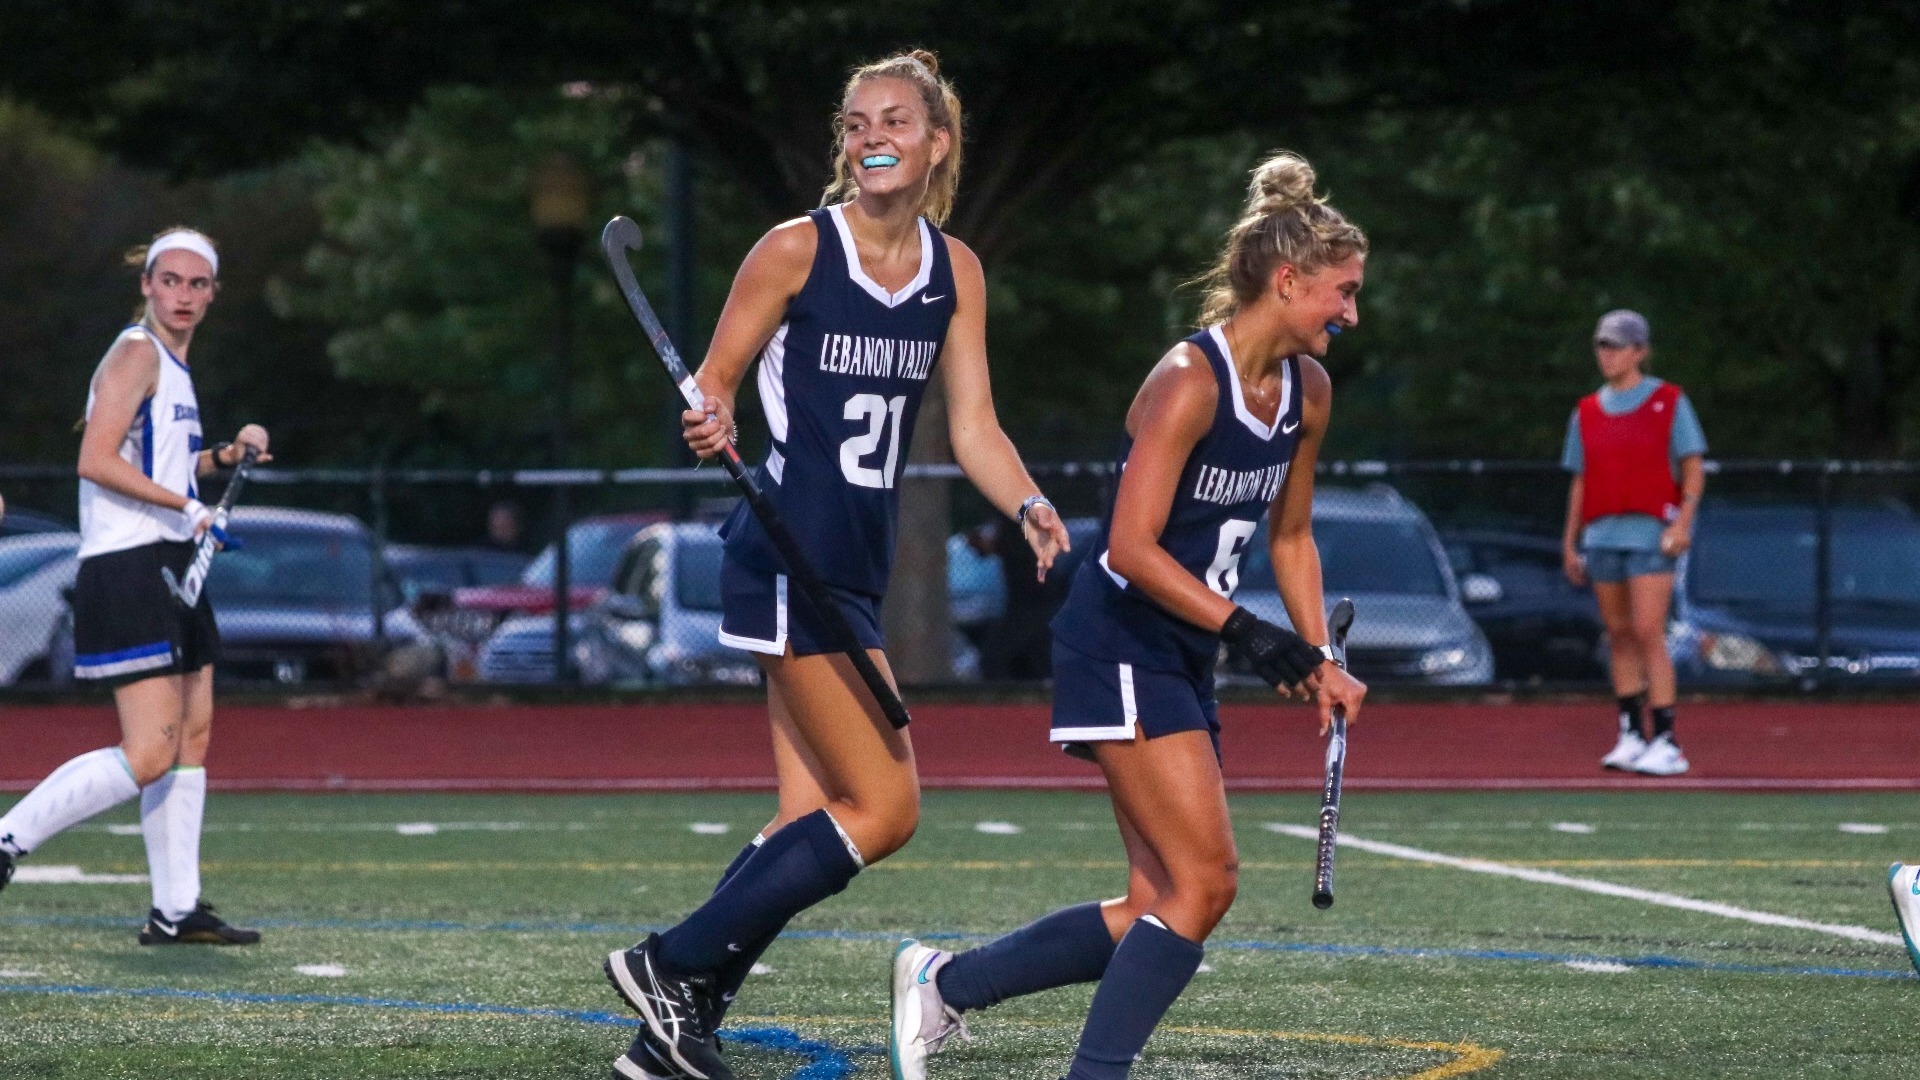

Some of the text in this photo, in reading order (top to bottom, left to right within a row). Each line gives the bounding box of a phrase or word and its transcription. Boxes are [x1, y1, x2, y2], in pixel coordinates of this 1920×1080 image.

[819, 333, 895, 379] LEBANON
[839, 393, 907, 489] 21
[1193, 464, 1265, 505] LEBANON
[1205, 518, 1257, 601] 6
